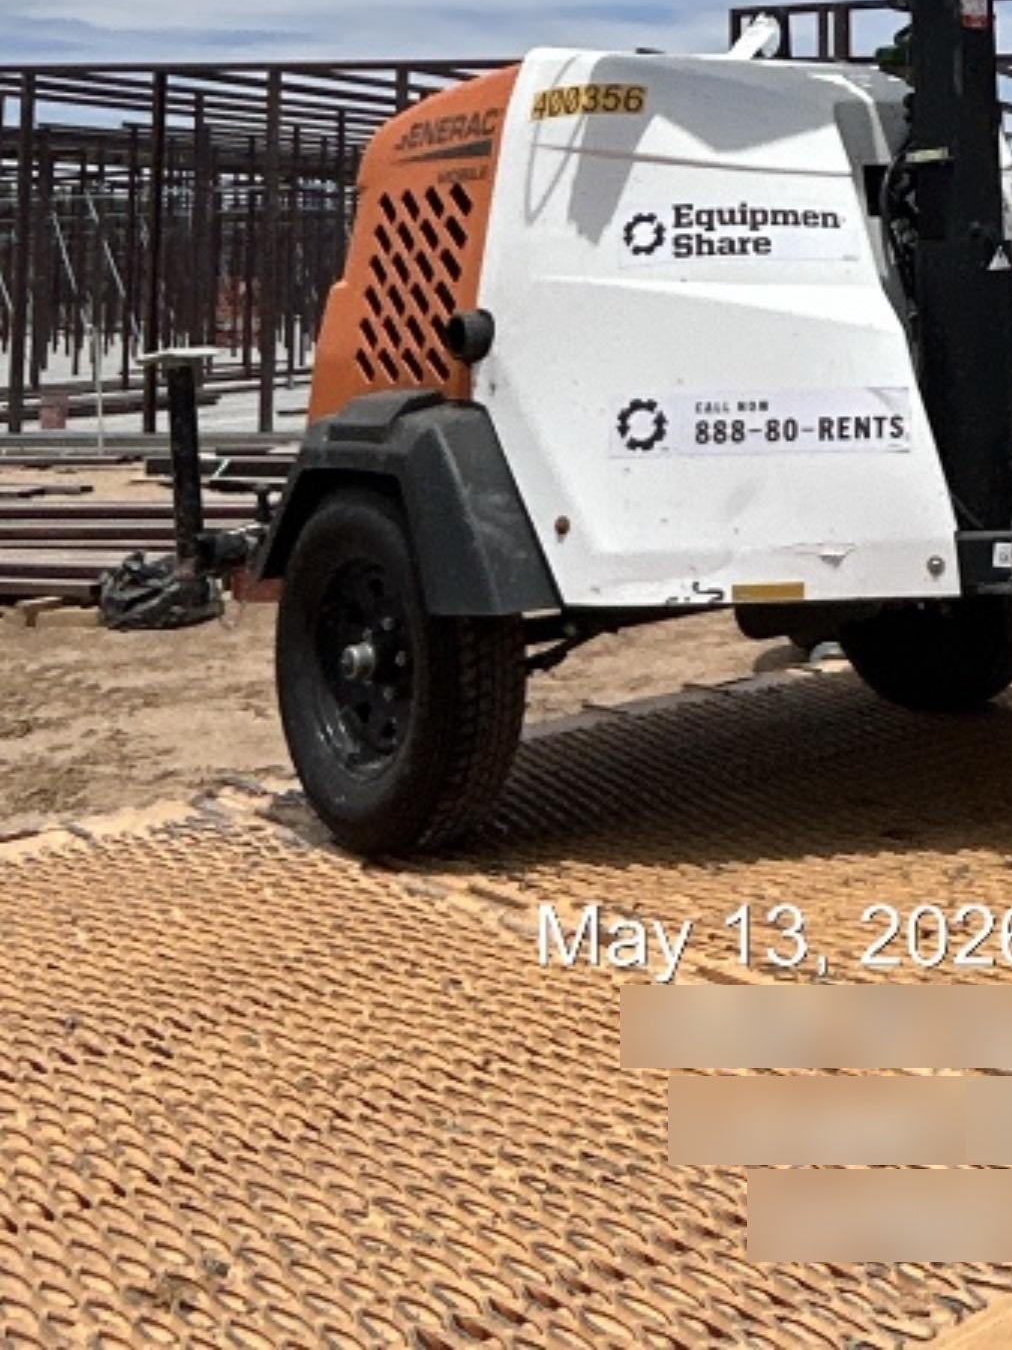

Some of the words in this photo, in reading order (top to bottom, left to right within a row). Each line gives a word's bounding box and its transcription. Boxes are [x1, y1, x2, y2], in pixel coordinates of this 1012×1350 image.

[532, 86, 646, 120] 400356
[672, 201, 841, 231] Equipmen
[672, 233, 772, 258] Share
[695, 401, 730, 414] CALL
[695, 415, 905, 444] 888-80-RENTS
